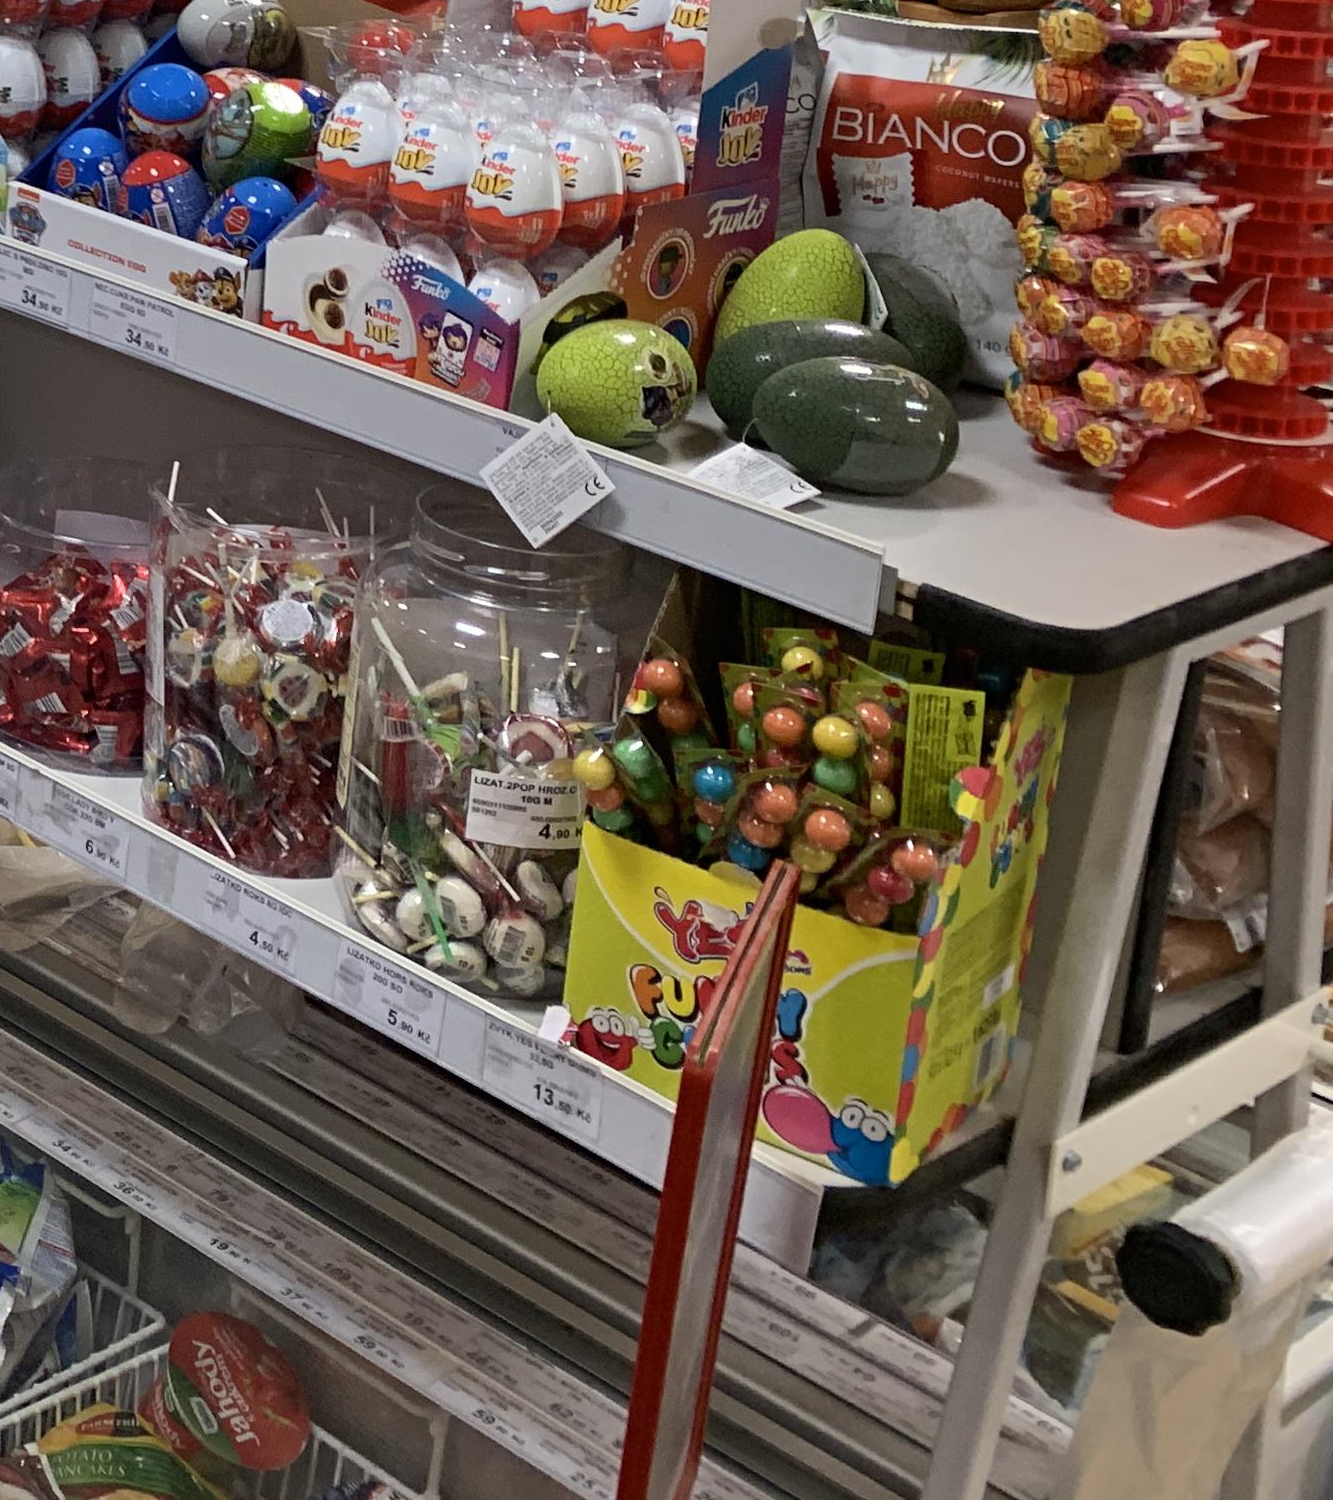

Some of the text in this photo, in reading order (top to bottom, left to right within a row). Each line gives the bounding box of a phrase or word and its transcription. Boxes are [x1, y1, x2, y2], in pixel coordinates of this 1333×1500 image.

[833, 107, 1026, 167] BIANCO
[853, 173, 898, 198] Happy
[935, 164, 1021, 190] COCONUT WAFERS
[347, 947, 381, 971] LIZATKO
